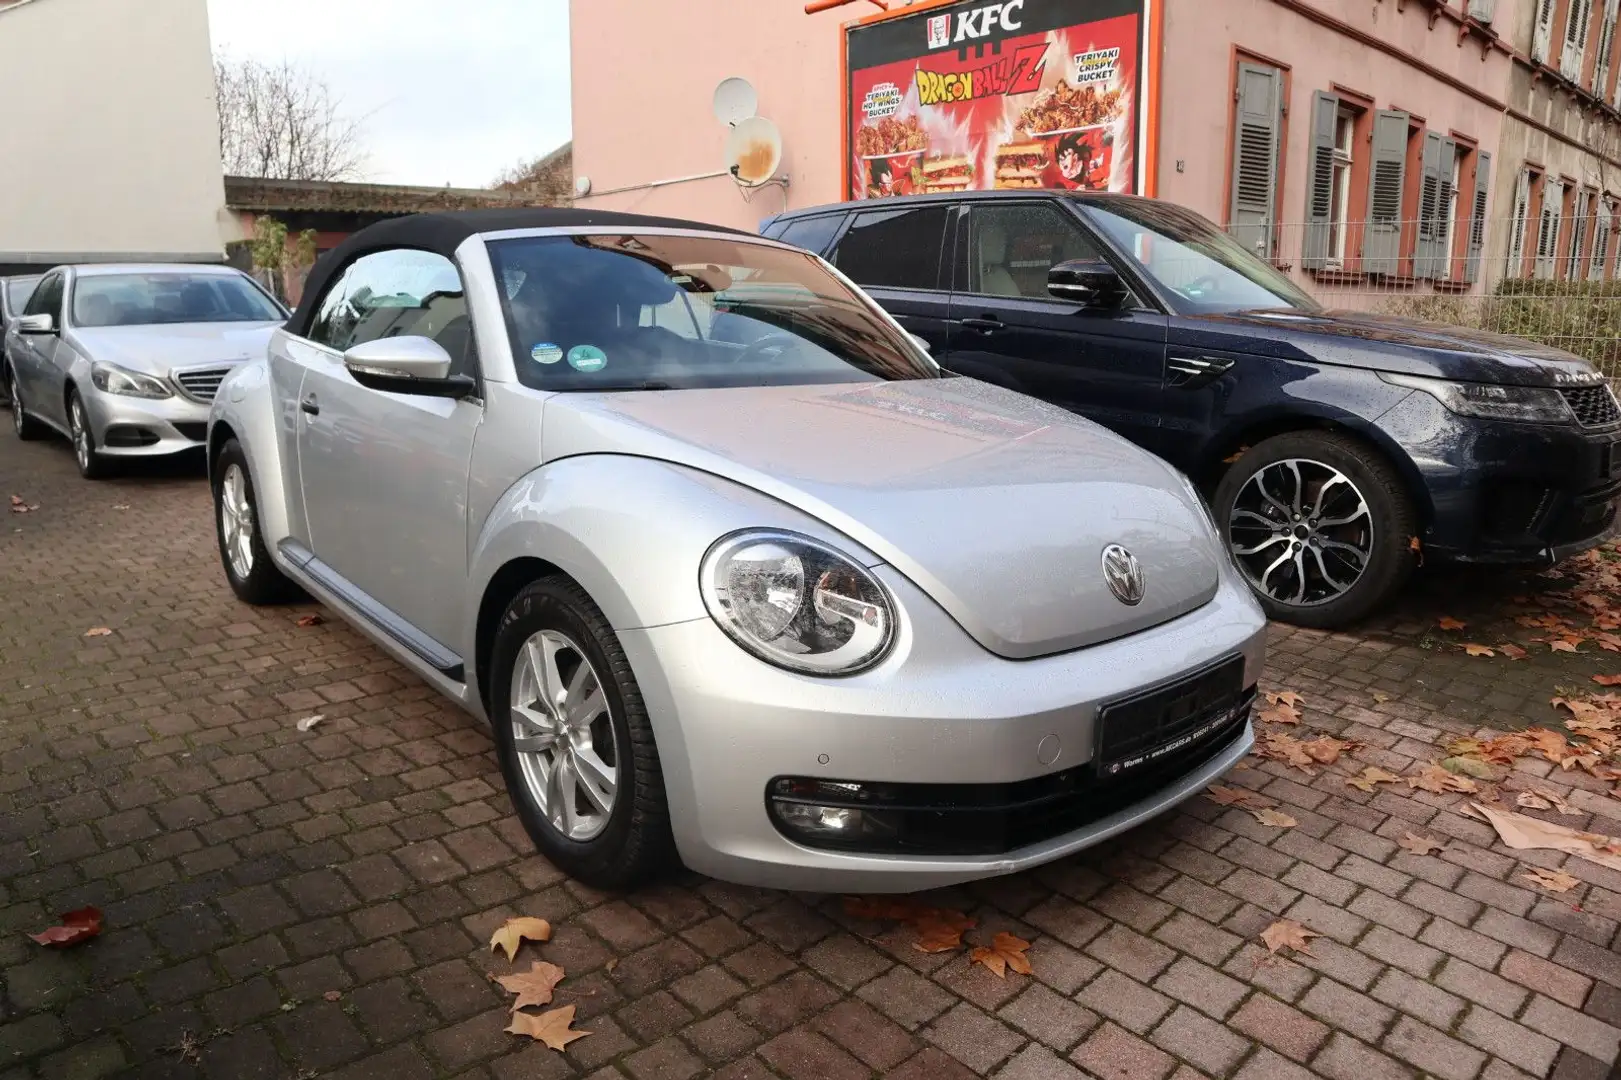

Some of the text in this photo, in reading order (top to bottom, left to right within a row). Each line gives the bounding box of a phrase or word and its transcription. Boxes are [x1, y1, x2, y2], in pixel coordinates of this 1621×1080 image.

[953, 0, 1024, 42] KFC
[1076, 49, 1118, 63] TERIYAKI
[1079, 60, 1112, 72] CRISPY
[1077, 70, 1114, 82] BUCKET
[867, 89, 897, 100] TERIYAKI
[878, 97, 900, 107] WINGS
[869, 106, 895, 117] BUCKET
[1123, 757, 1144, 768] Worms
